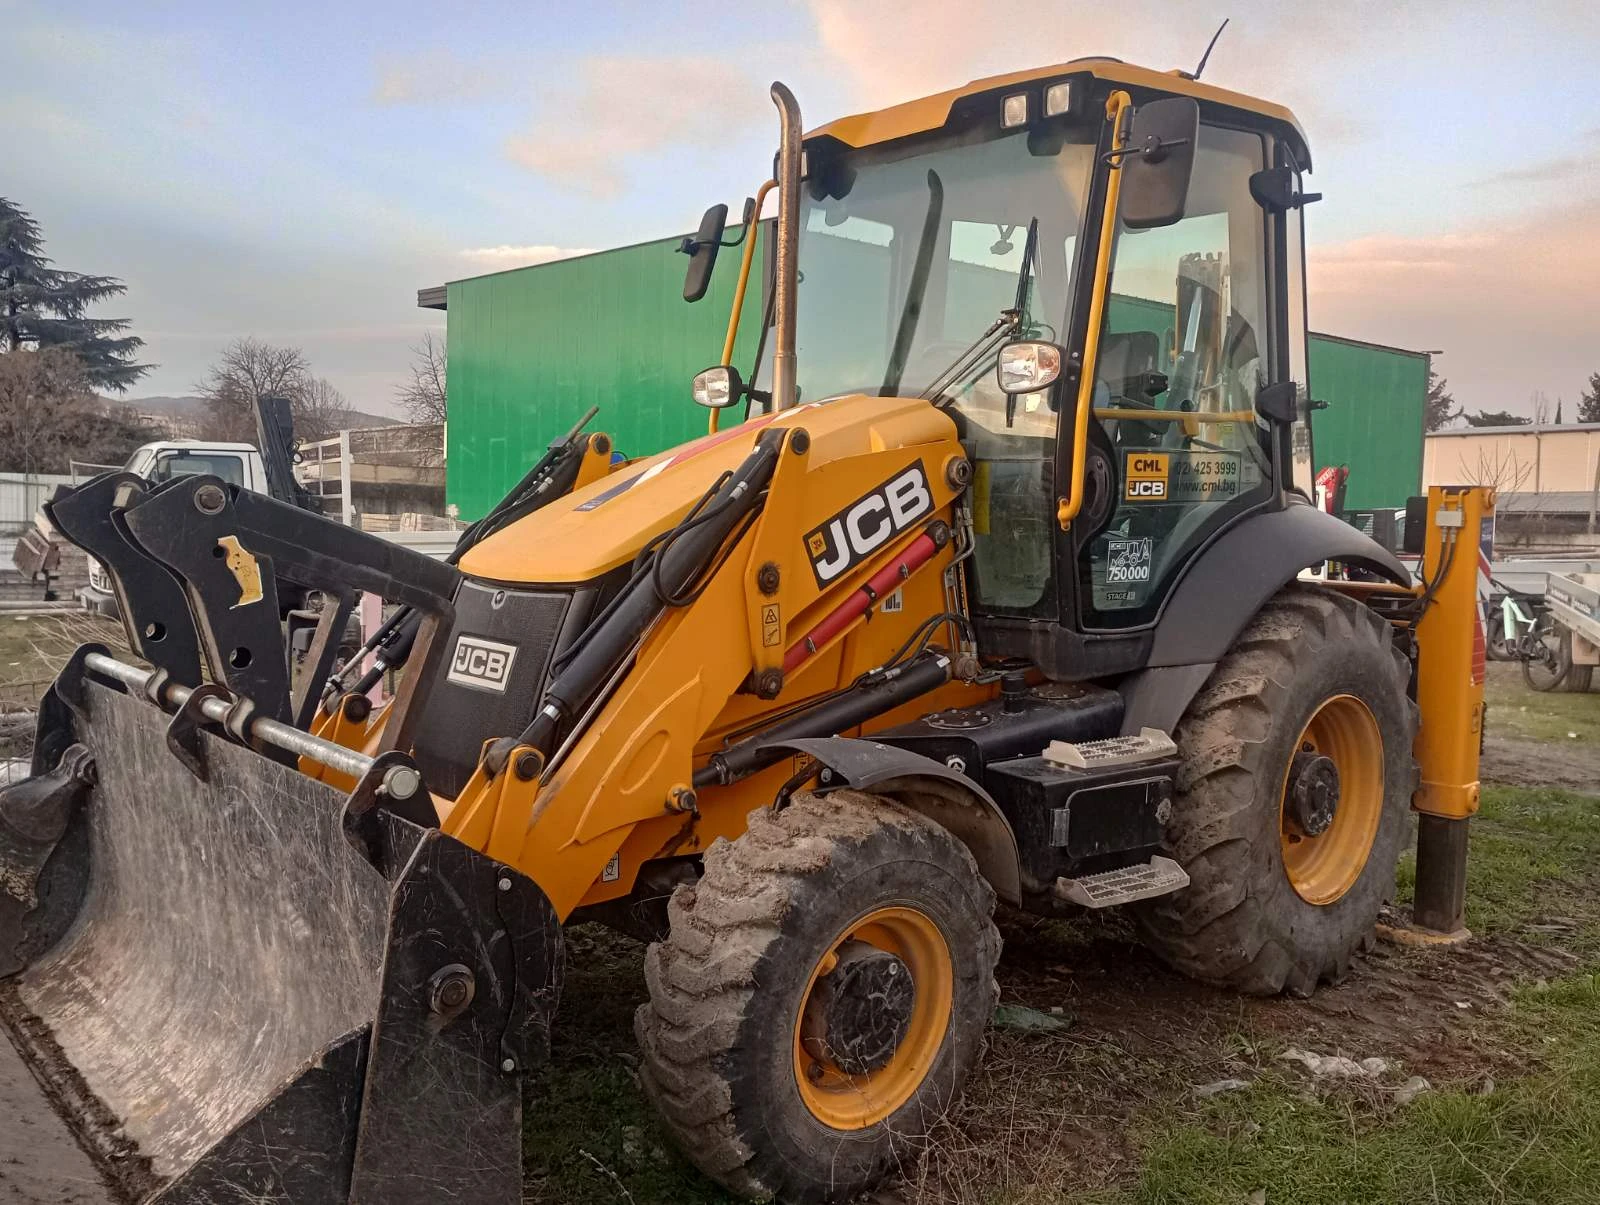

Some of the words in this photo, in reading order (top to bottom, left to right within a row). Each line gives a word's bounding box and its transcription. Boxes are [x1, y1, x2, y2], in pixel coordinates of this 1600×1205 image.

[1134, 459, 1162, 472] CML
[1194, 461, 1212, 475] 425
[1214, 461, 1237, 475] 3999
[1129, 481, 1164, 496] JCB
[815, 467, 930, 581] JCB
[455, 646, 507, 680] JCB
